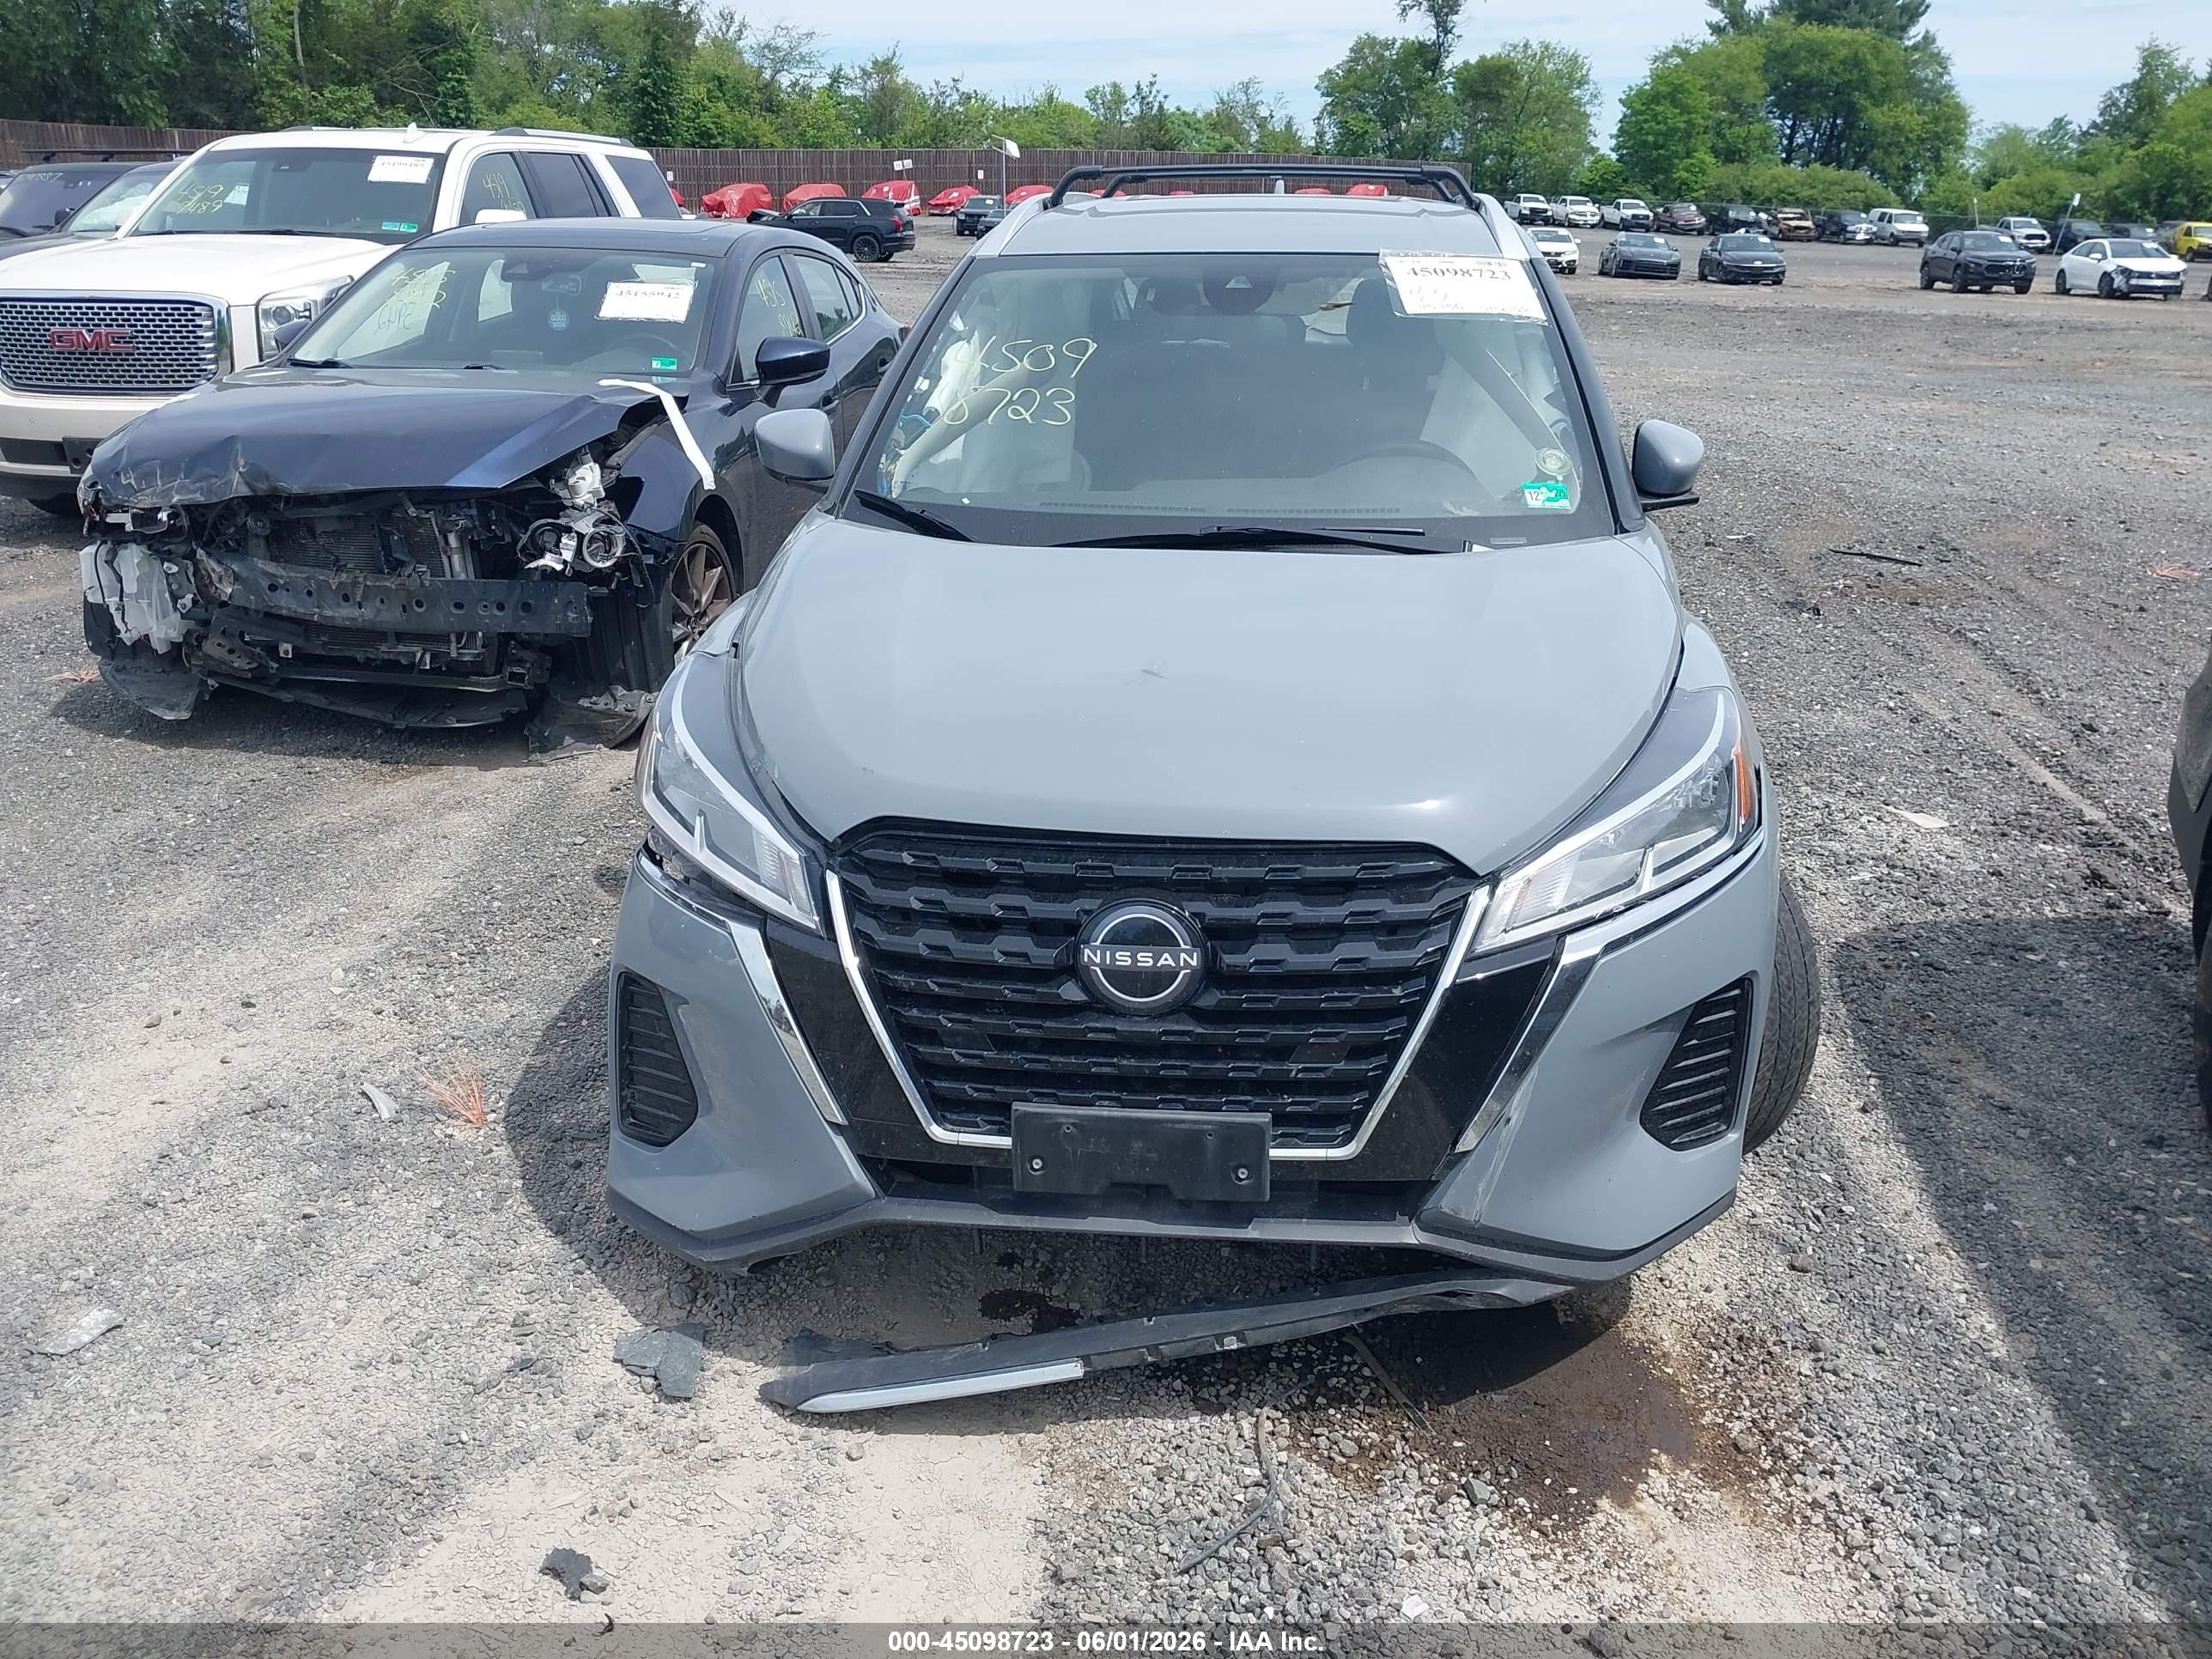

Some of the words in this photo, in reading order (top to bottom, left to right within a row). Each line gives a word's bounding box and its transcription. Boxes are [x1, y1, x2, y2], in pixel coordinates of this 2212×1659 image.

[1406, 266, 1511, 281] 45098723
[49, 329, 136, 351] GMC
[955, 336, 1098, 379] 4509
[1083, 948, 1198, 967] NISSAN
